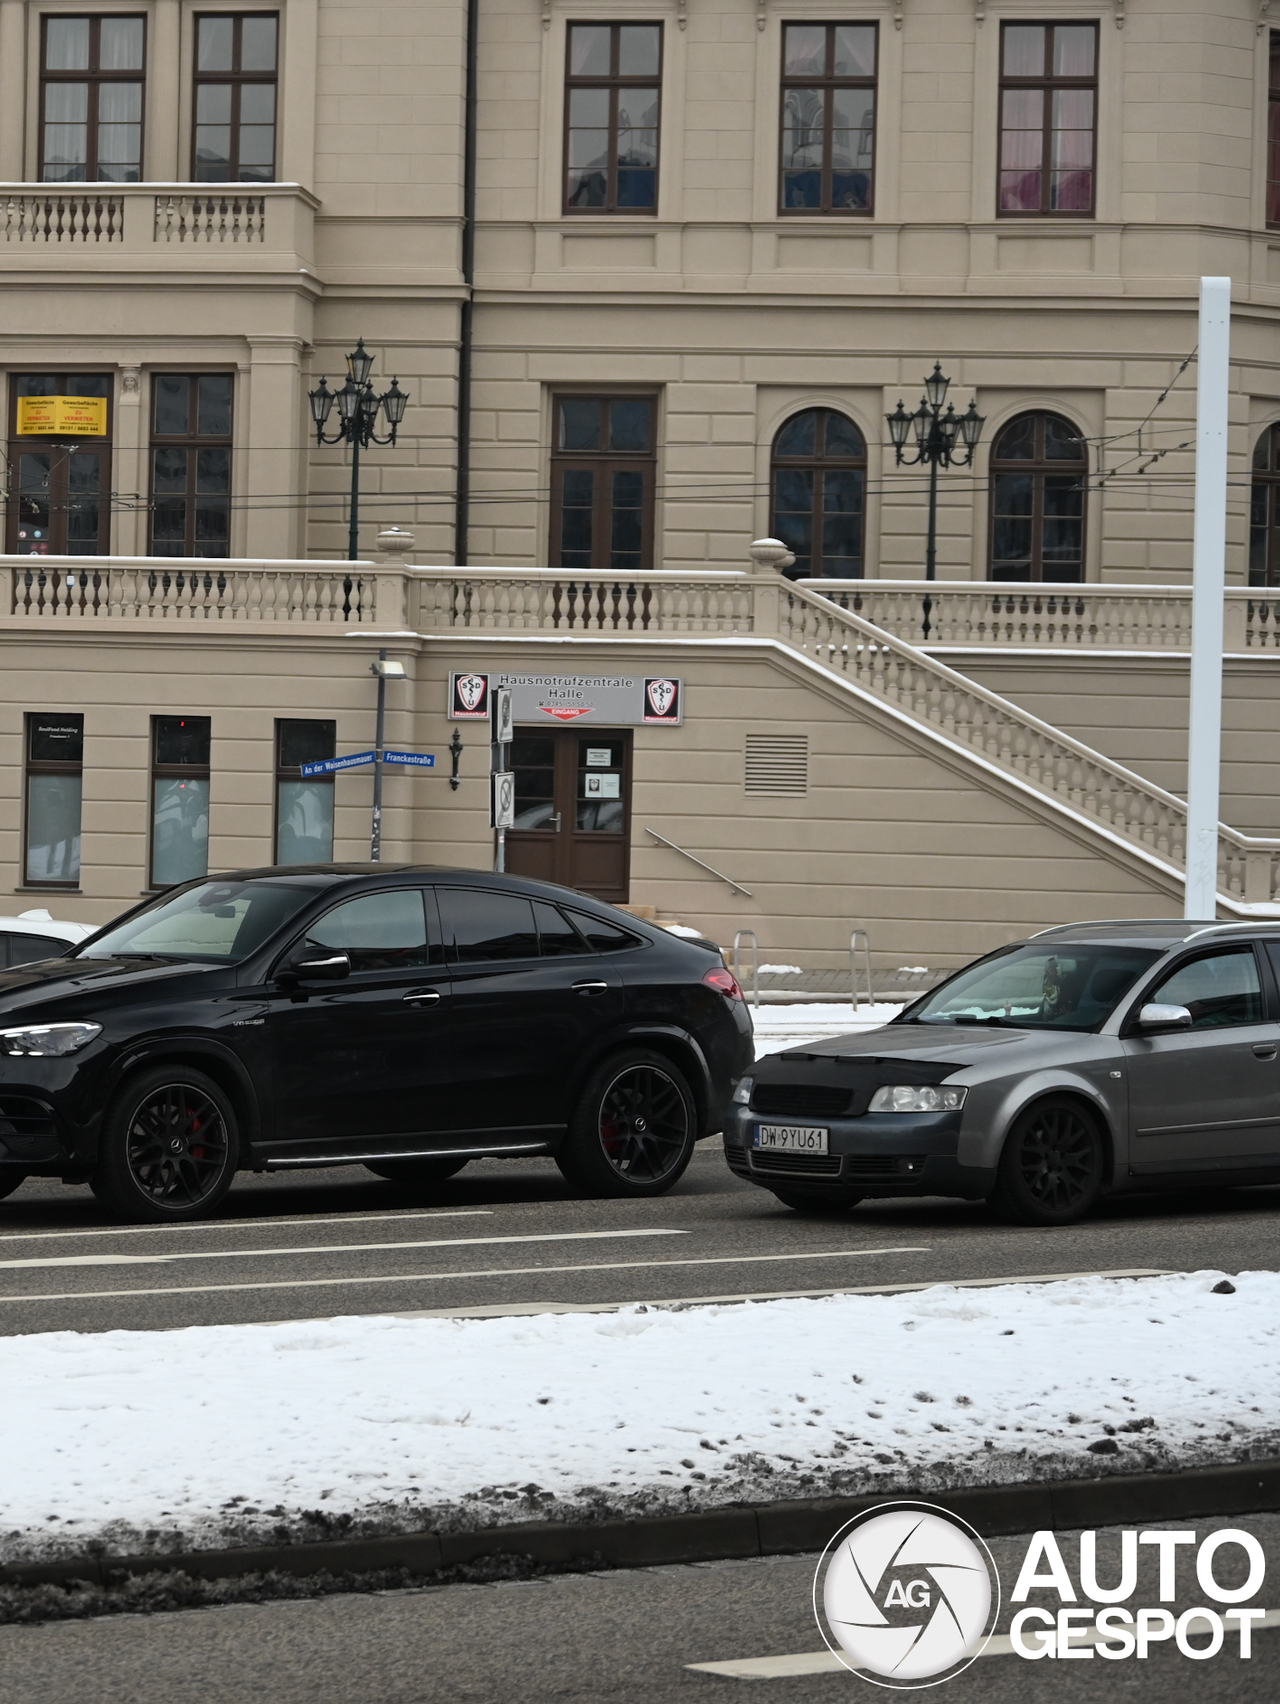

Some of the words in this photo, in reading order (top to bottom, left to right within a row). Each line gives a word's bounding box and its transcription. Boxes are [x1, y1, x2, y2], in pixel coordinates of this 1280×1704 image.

[500, 675, 633, 688] Hausnotrufzentrale
[549, 688, 584, 699] Halle
[325, 754, 372, 770] Waisenhausmauer
[387, 753, 431, 764] Franckestraße
[762, 1128, 776, 1146] DW
[781, 1129, 822, 1149] 9YU61
